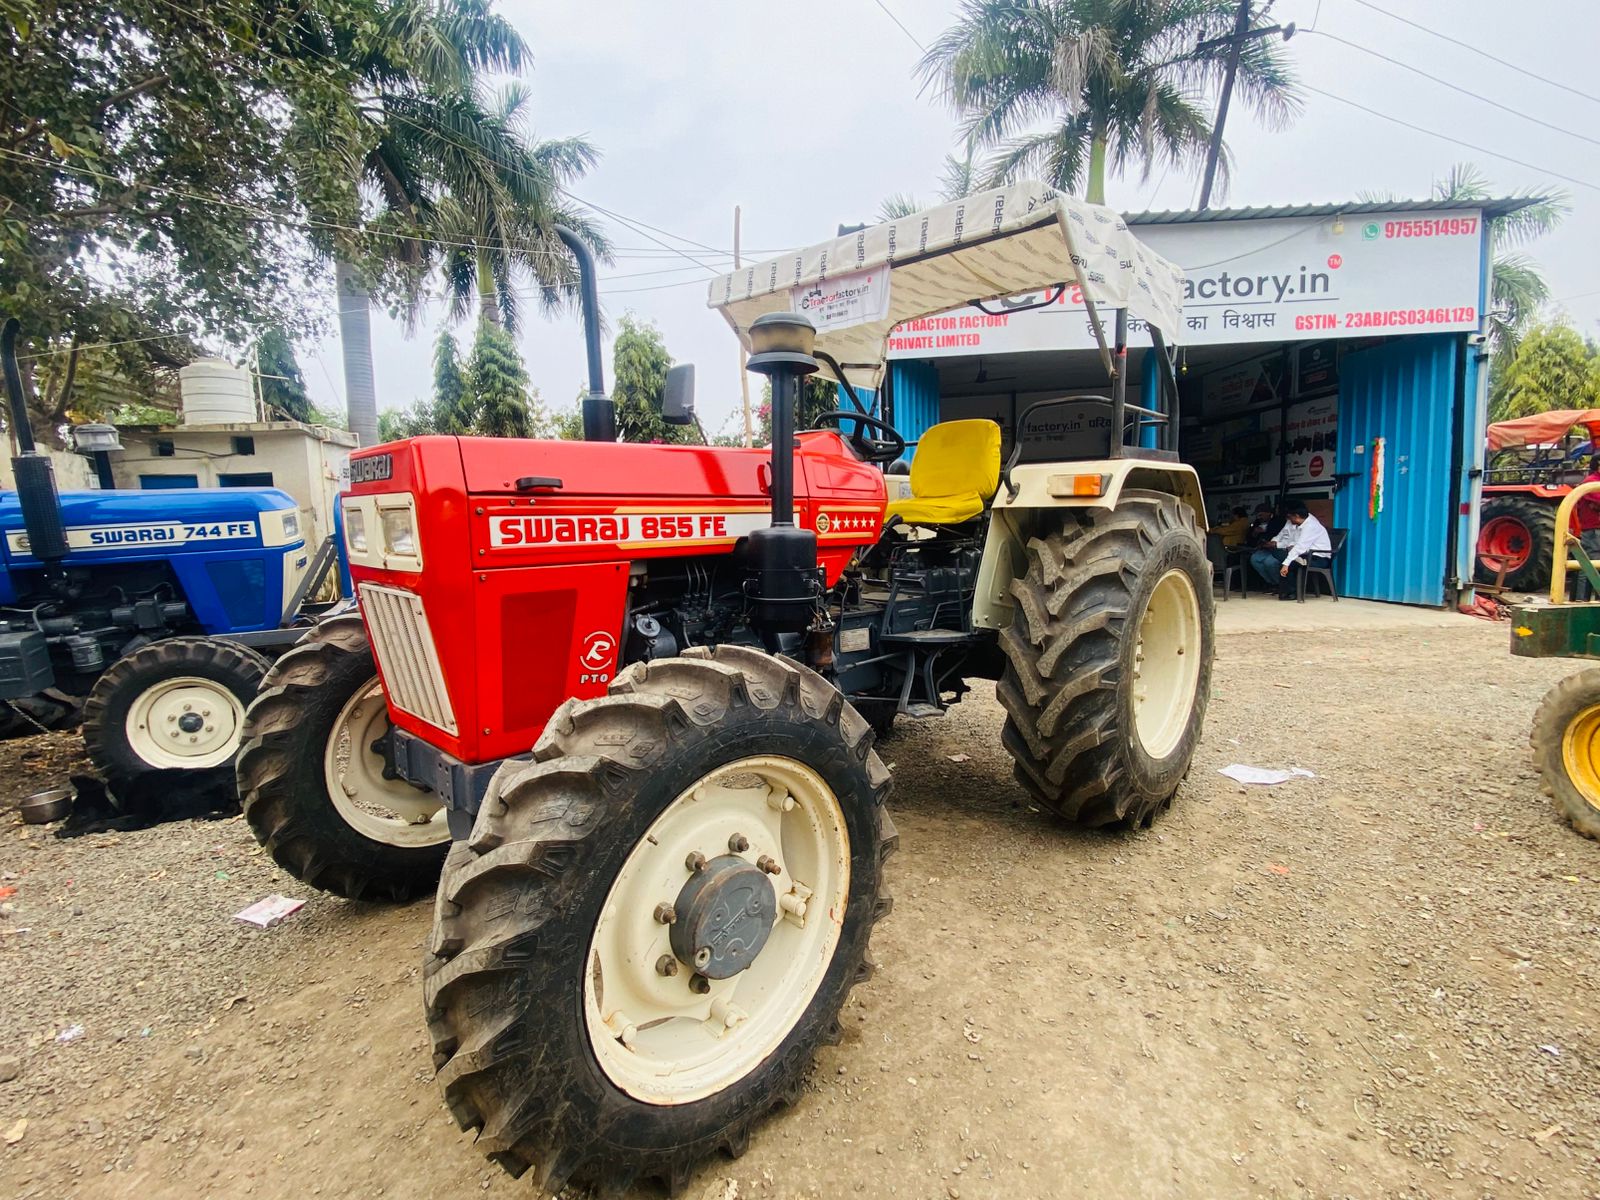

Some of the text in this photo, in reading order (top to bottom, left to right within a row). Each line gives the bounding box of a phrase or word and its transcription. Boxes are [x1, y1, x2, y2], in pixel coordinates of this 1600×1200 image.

[1384, 218, 1477, 239] 9755514957
[907, 317, 957, 332] TRACTOR
[960, 314, 1009, 329] FACTORY
[1187, 316, 1208, 330] का
[1222, 310, 1277, 329] विश्वास
[1295, 314, 1342, 331] GSTIN-
[889, 334, 981, 350] PRIVATE LIMITED
[183, 525, 221, 539] 744
[227, 524, 251, 536] FE
[641, 517, 693, 539] 855
[700, 516, 727, 537] FE
[580, 673, 609, 684] PTO
